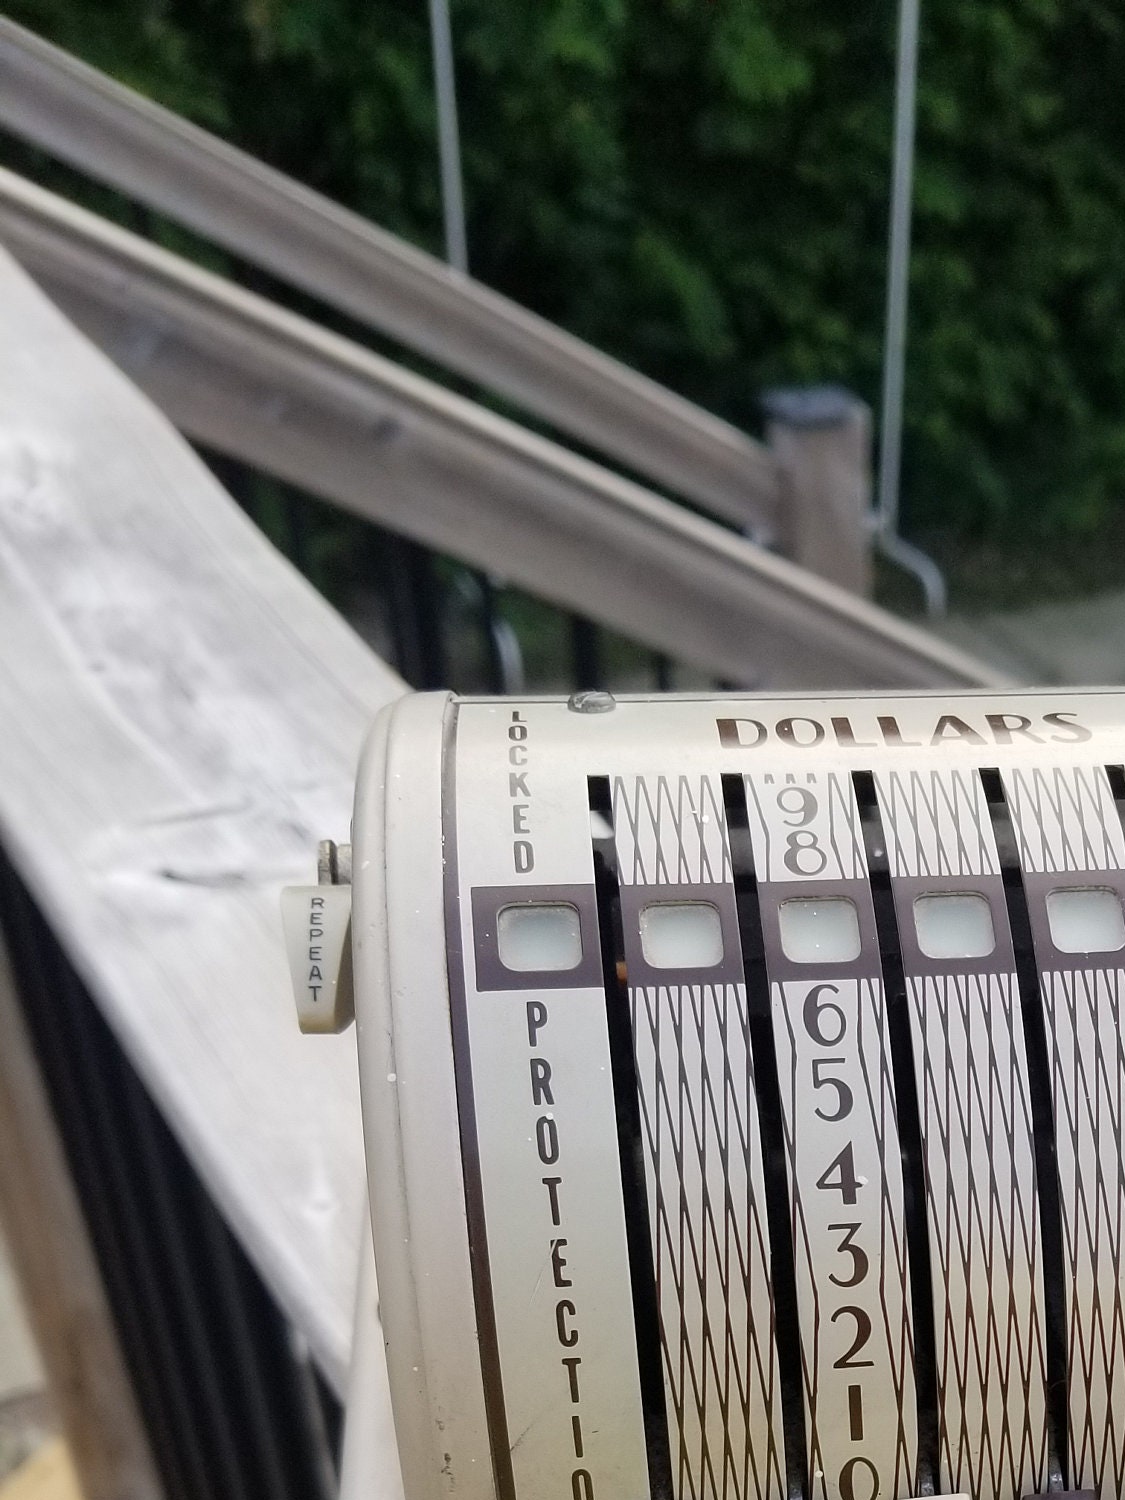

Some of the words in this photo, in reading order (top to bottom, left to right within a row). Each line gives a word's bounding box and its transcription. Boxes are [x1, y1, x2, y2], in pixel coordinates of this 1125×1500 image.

[716, 711, 1093, 749] DOLLARS
[507, 711, 535, 875] LOCKED
[776, 787, 818, 827] 9
[783, 830, 828, 877] 8
[308, 898, 325, 1002] REPEAT
[802, 984, 847, 1046] 6
[811, 1057, 854, 1122] 5
[815, 1141, 864, 1205] 4
[827, 1223, 870, 1287] 3
[830, 1305, 875, 1369] 2
